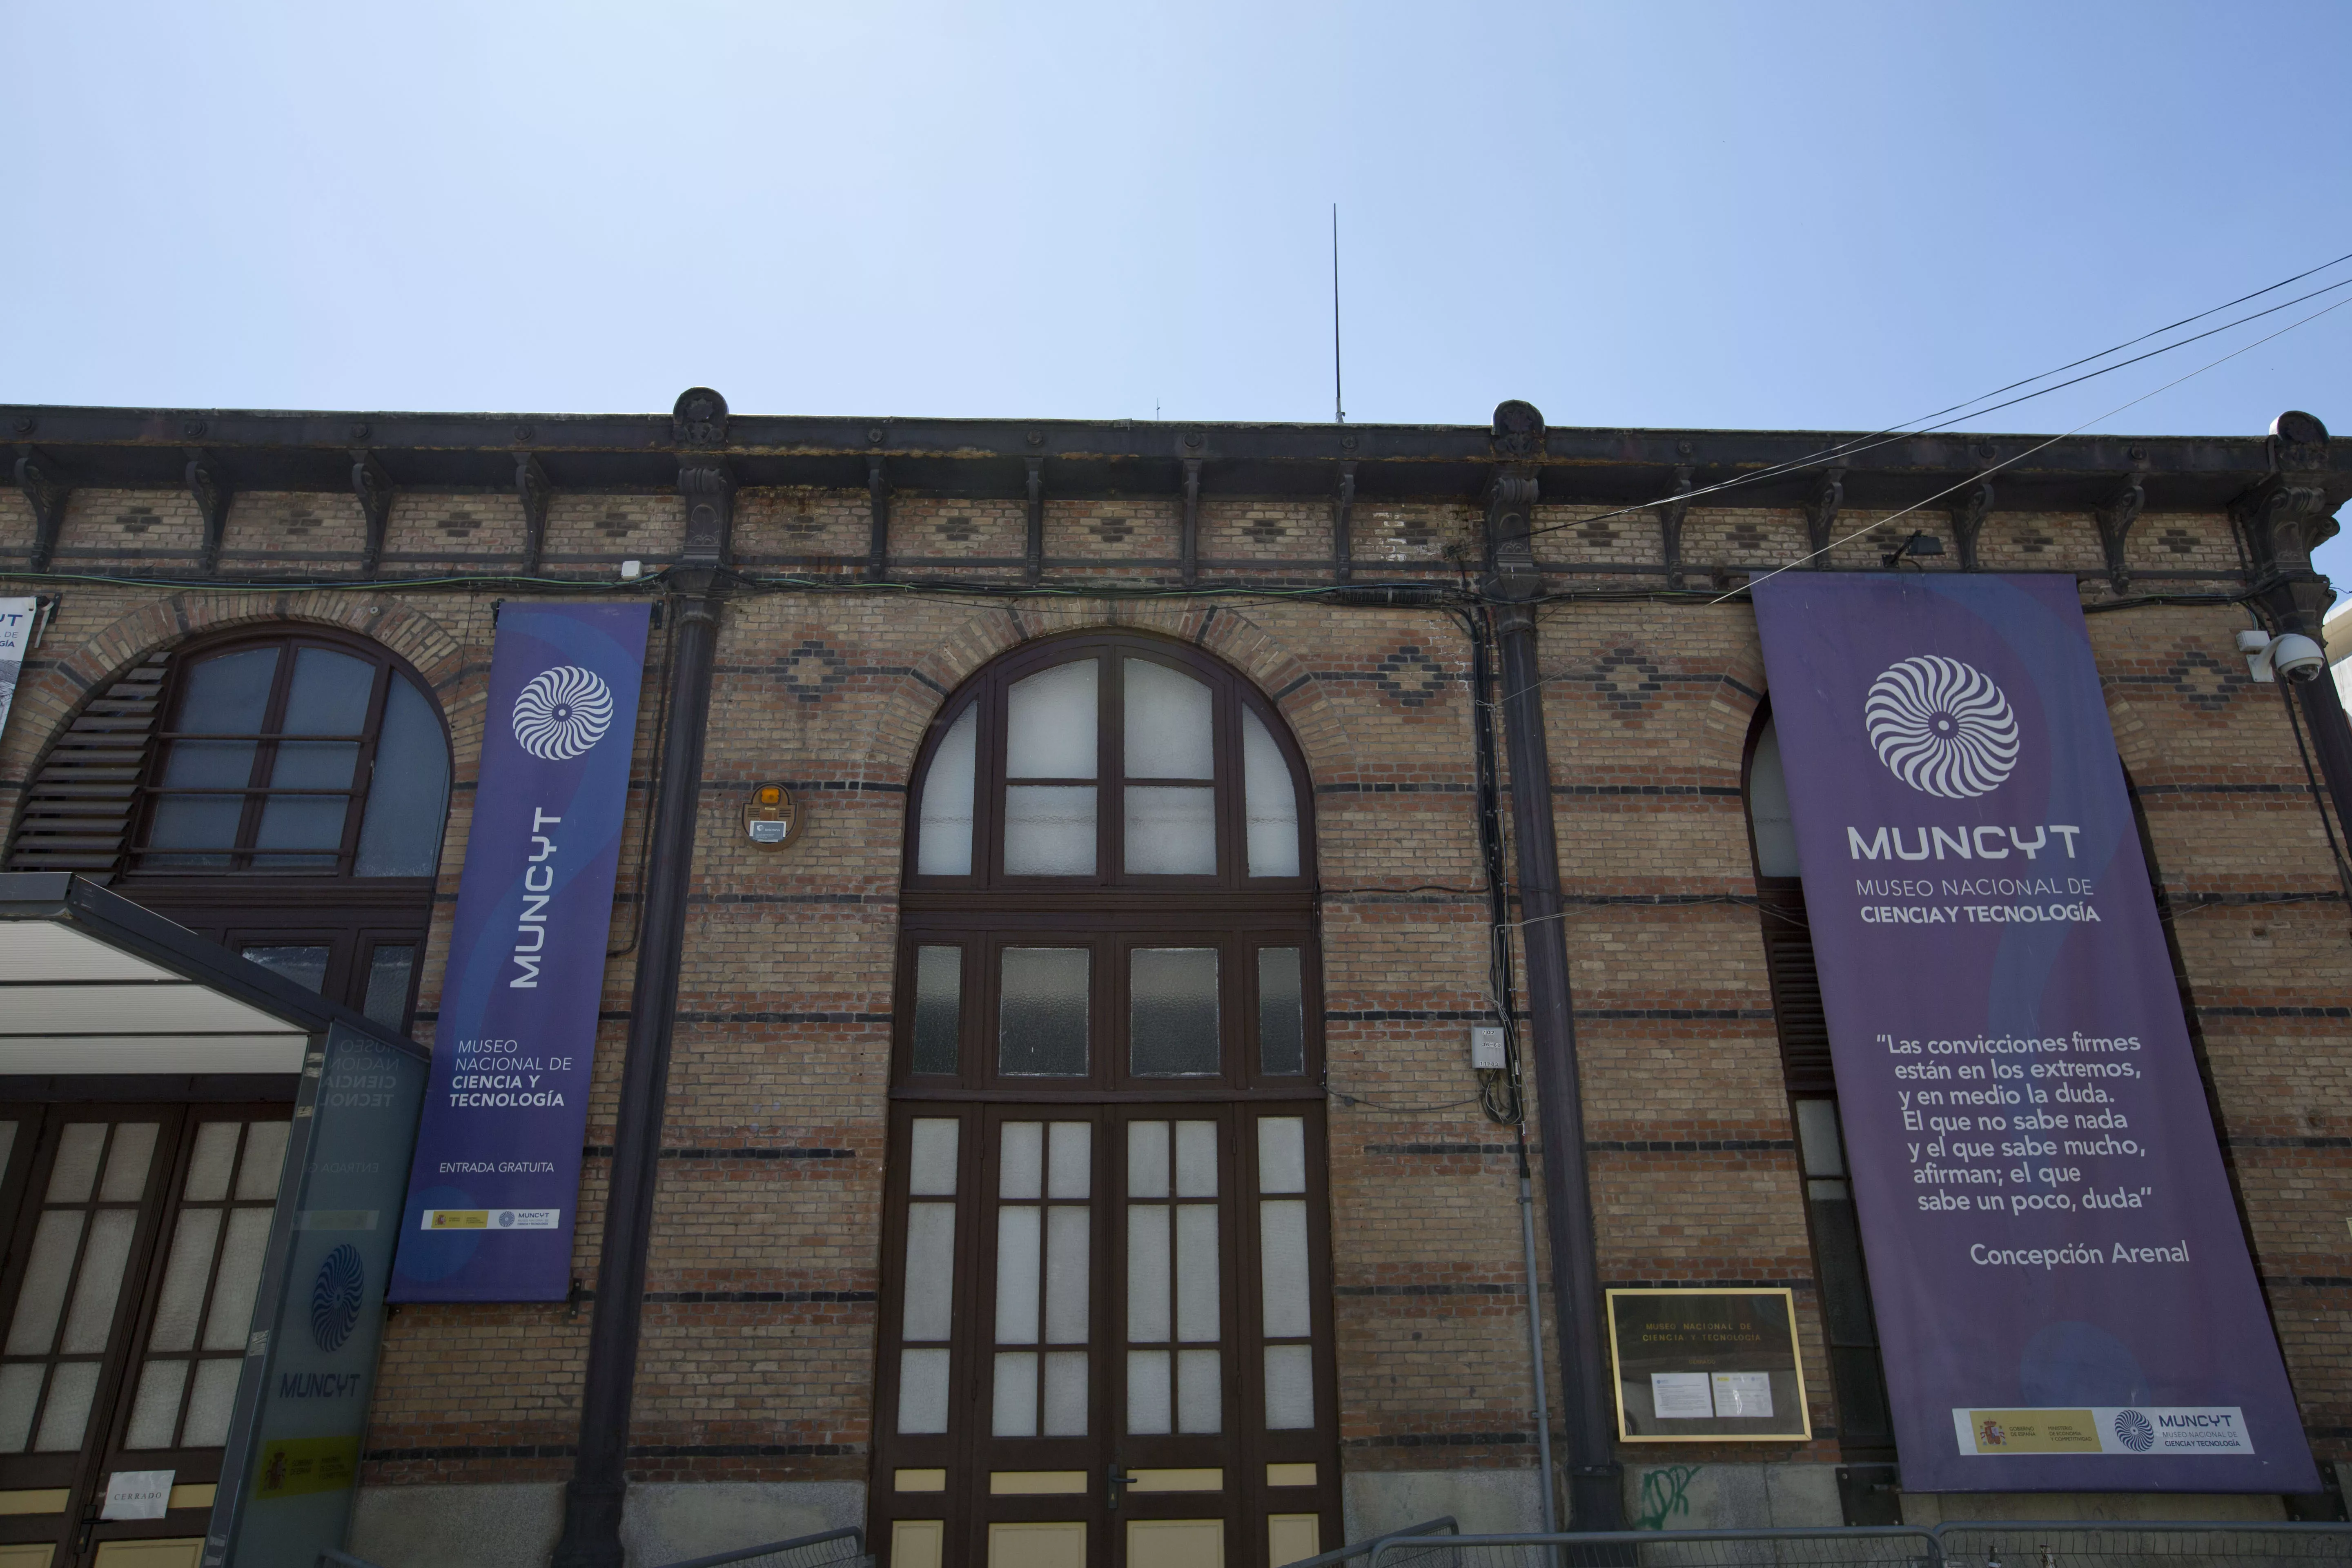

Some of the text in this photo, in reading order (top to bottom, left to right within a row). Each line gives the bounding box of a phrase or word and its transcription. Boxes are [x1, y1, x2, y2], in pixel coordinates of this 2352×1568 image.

[1847, 825, 2080, 860] MUNCYT
[510, 807, 561, 987] MUNCYT
[1856, 878, 2094, 896] MUSEO NACIONAL DE
[1861, 901, 2101, 923] CIENCIA Y TECNOLOGÍA
[459, 1040, 517, 1053] MUSEO
[1877, 1031, 2140, 1054] "Las convicciones firmes
[456, 1058, 572, 1070] NACIONAL DE
[1895, 1059, 2140, 1079] están en los extremos,
[453, 1076, 540, 1089] CIENCIA Y
[450, 1090, 564, 1106] TECNOLOGÍA
[1898, 1082, 2114, 1110] y en medio la duda.
[1903, 1108, 2127, 1136] El que no sabe nada
[1908, 1134, 2145, 1163] y el que sabe mucho,
[440, 1163, 554, 1173] ENTRADA GRATUITA
[1914, 1162, 2080, 1187] afirman; el que
[1918, 1187, 2151, 1216] sabe un poco, duda"
[1971, 1240, 2189, 1270] Concepción Arenal
[279, 1373, 361, 1398] MUNCYT
[2158, 1415, 2232, 1427] MUNCYT
[114, 1492, 162, 1500] CERRADO
